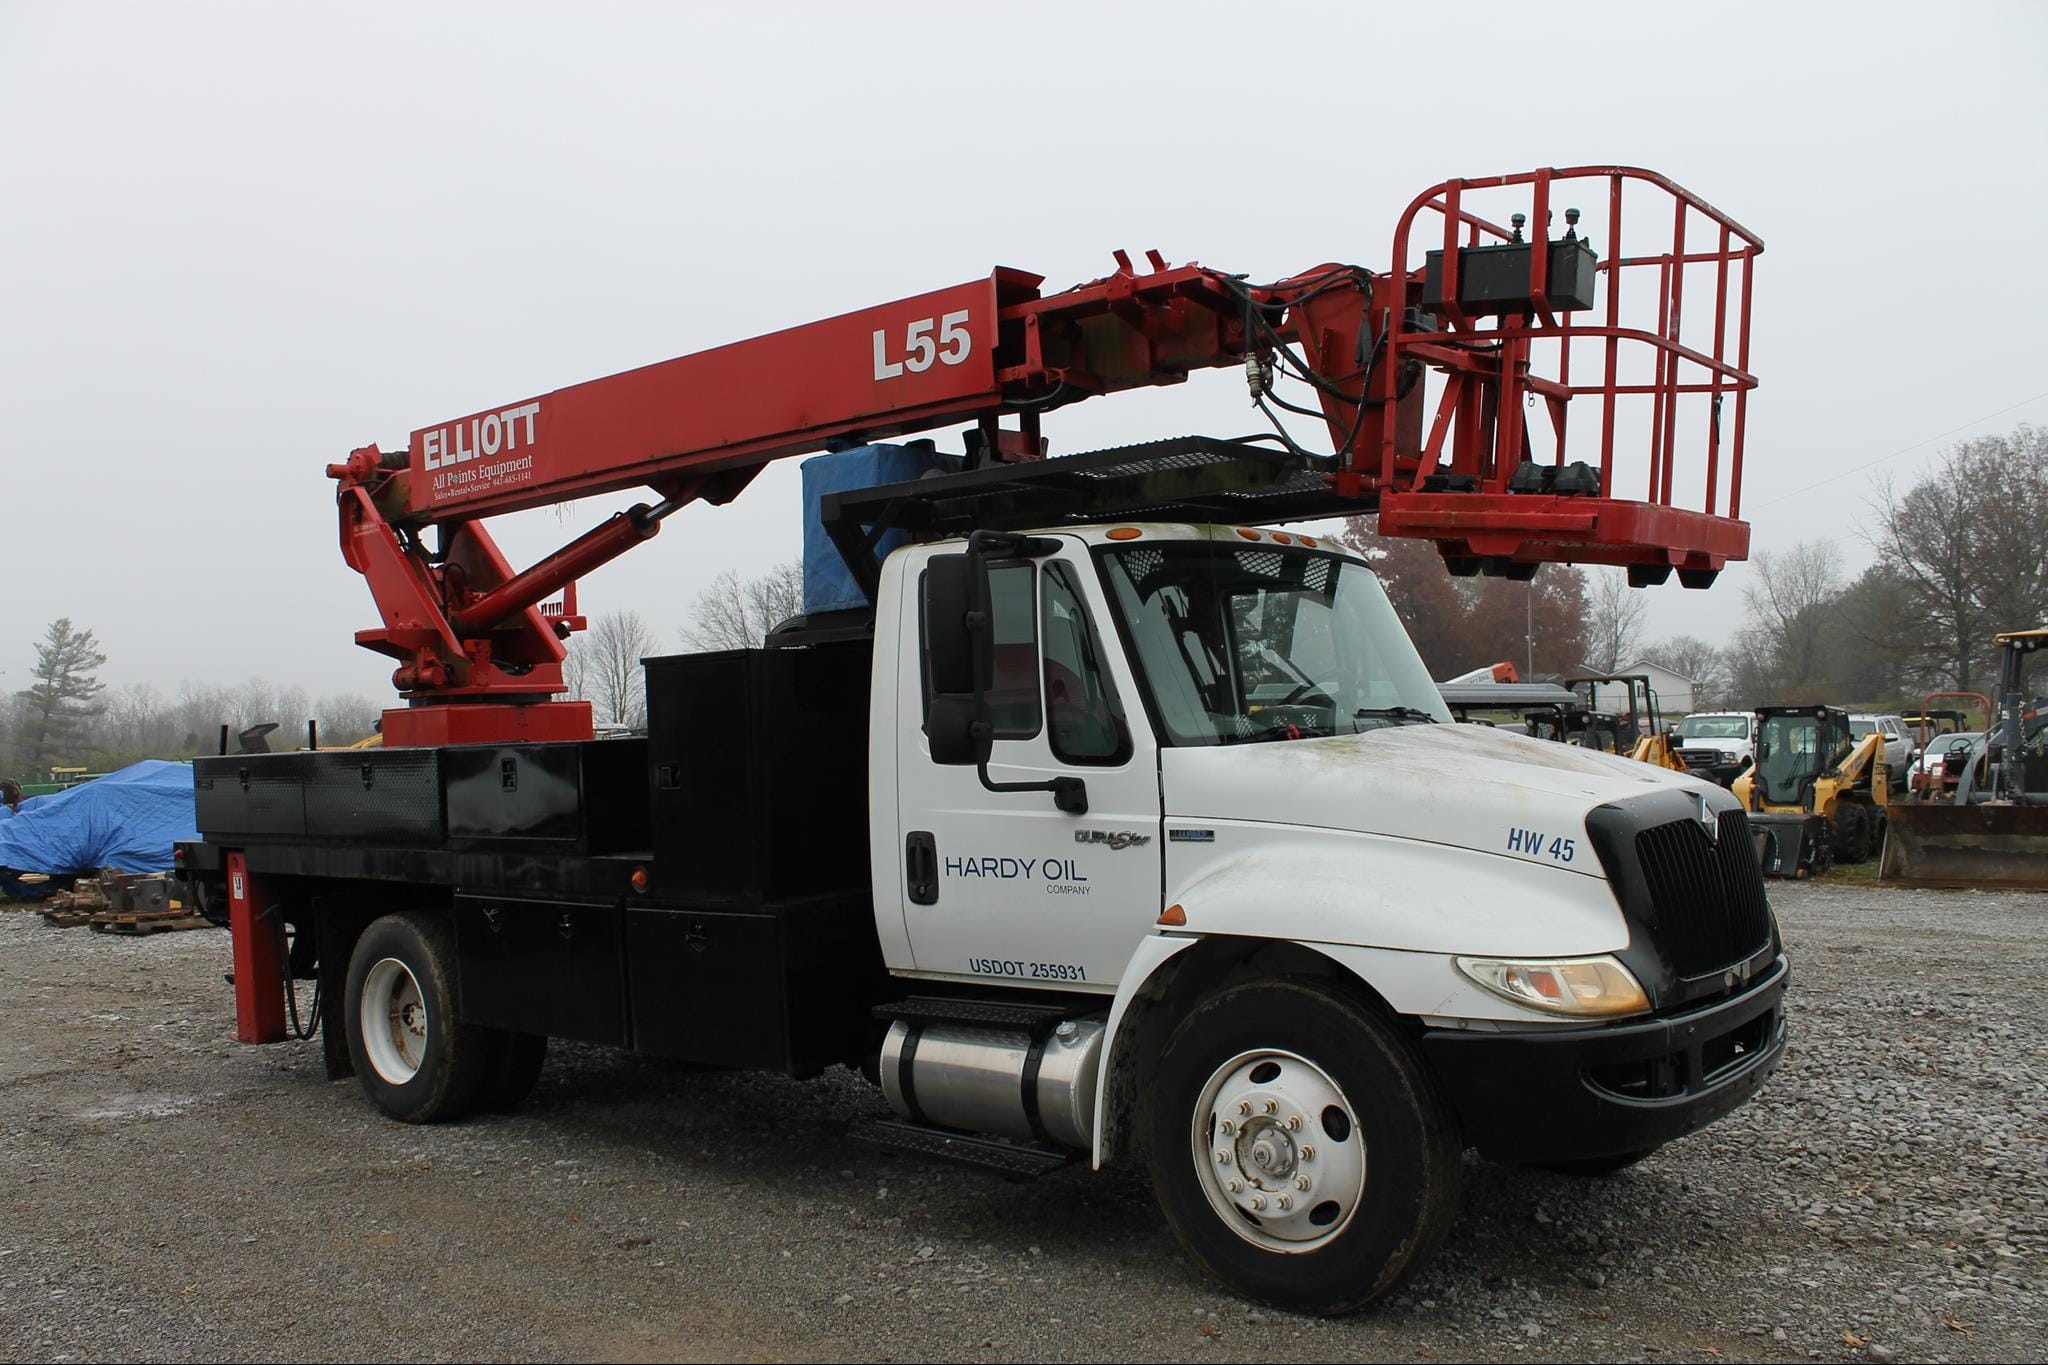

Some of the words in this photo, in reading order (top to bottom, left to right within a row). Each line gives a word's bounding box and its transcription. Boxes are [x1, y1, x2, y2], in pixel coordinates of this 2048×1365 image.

[873, 309, 972, 381] L55
[423, 402, 540, 472] ELLIOTT
[432, 474, 446, 491] All
[479, 454, 533, 481] Equipment
[1507, 827, 1545, 855] HW
[1548, 837, 1576, 862] 45
[945, 856, 1036, 879] HARDY
[1042, 858, 1088, 881] OIL
[1046, 884, 1092, 896] COMPANY
[968, 957, 1025, 977] USDOT
[1029, 962, 1087, 981] 255931
